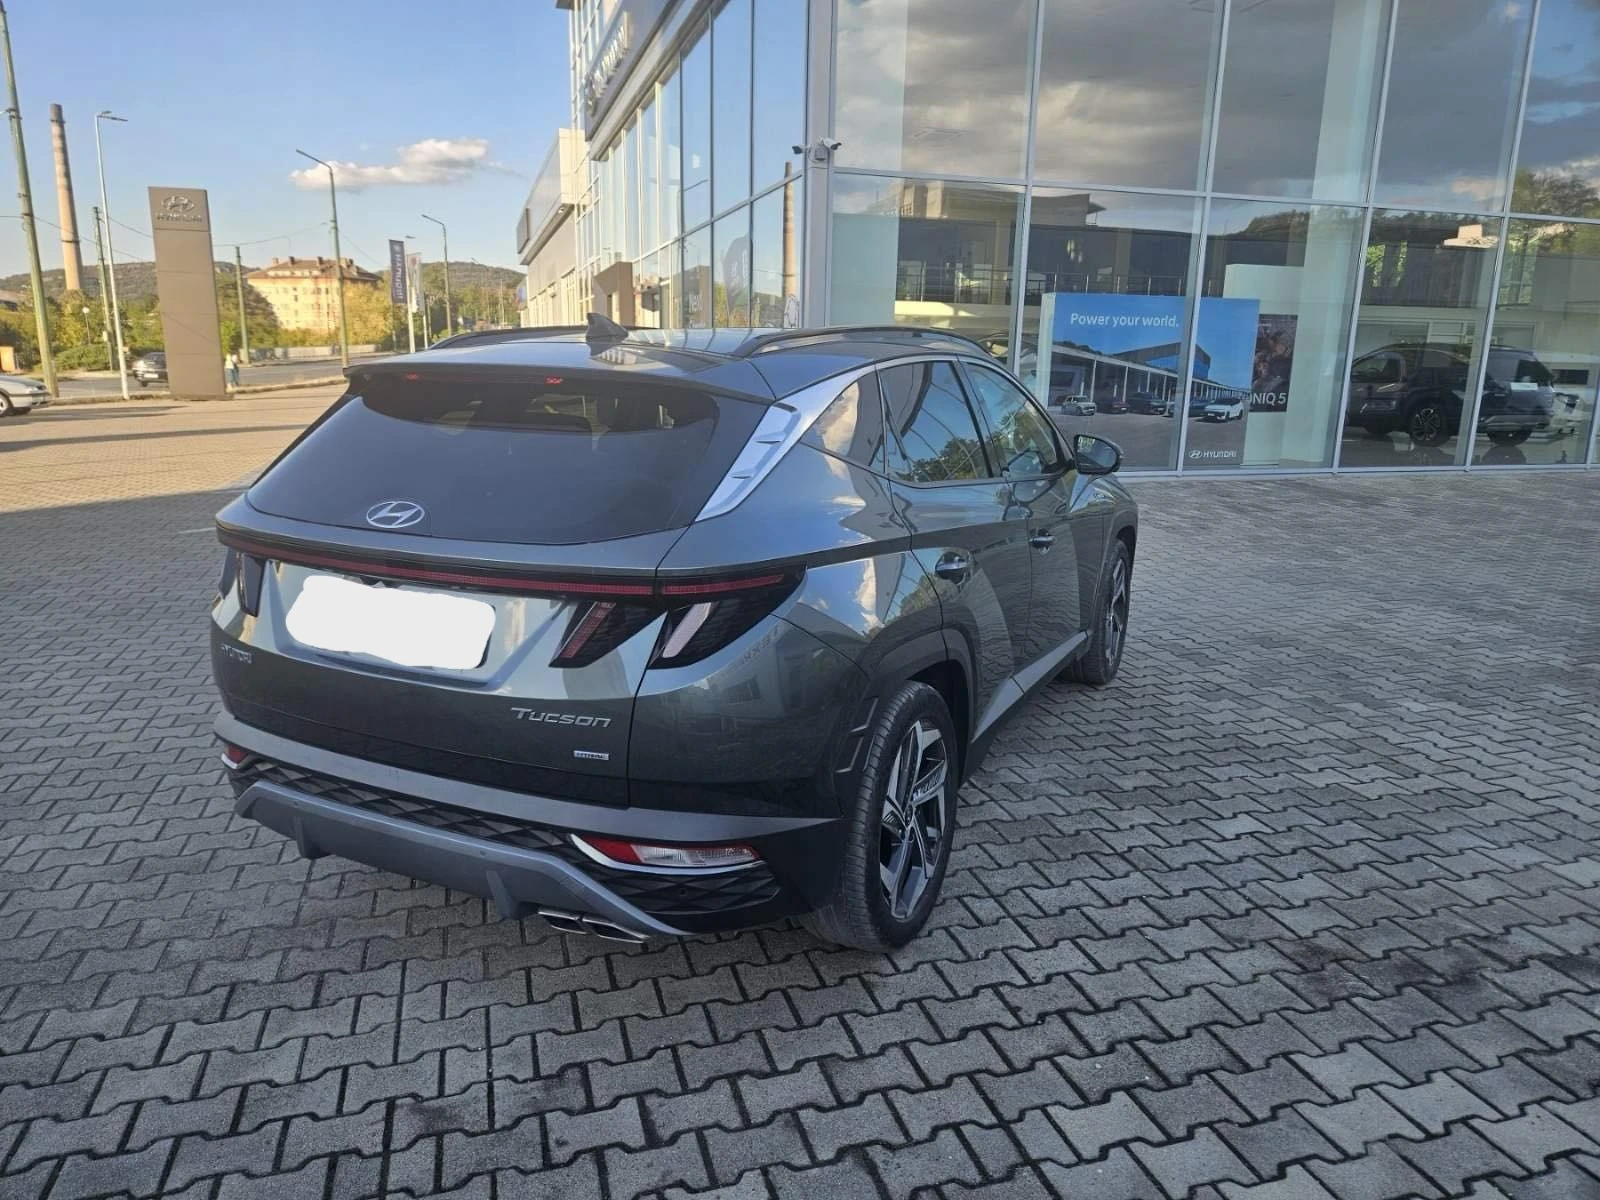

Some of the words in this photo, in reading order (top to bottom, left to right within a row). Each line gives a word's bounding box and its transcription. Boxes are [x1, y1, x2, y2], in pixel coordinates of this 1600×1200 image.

[1070, 312, 1109, 326] Power
[1112, 315, 1141, 328] your
[1142, 315, 1179, 328] world.
[1249, 391, 1275, 406] NIQ
[1278, 392, 1287, 404] 5
[1203, 450, 1237, 458] HYUNDAI
